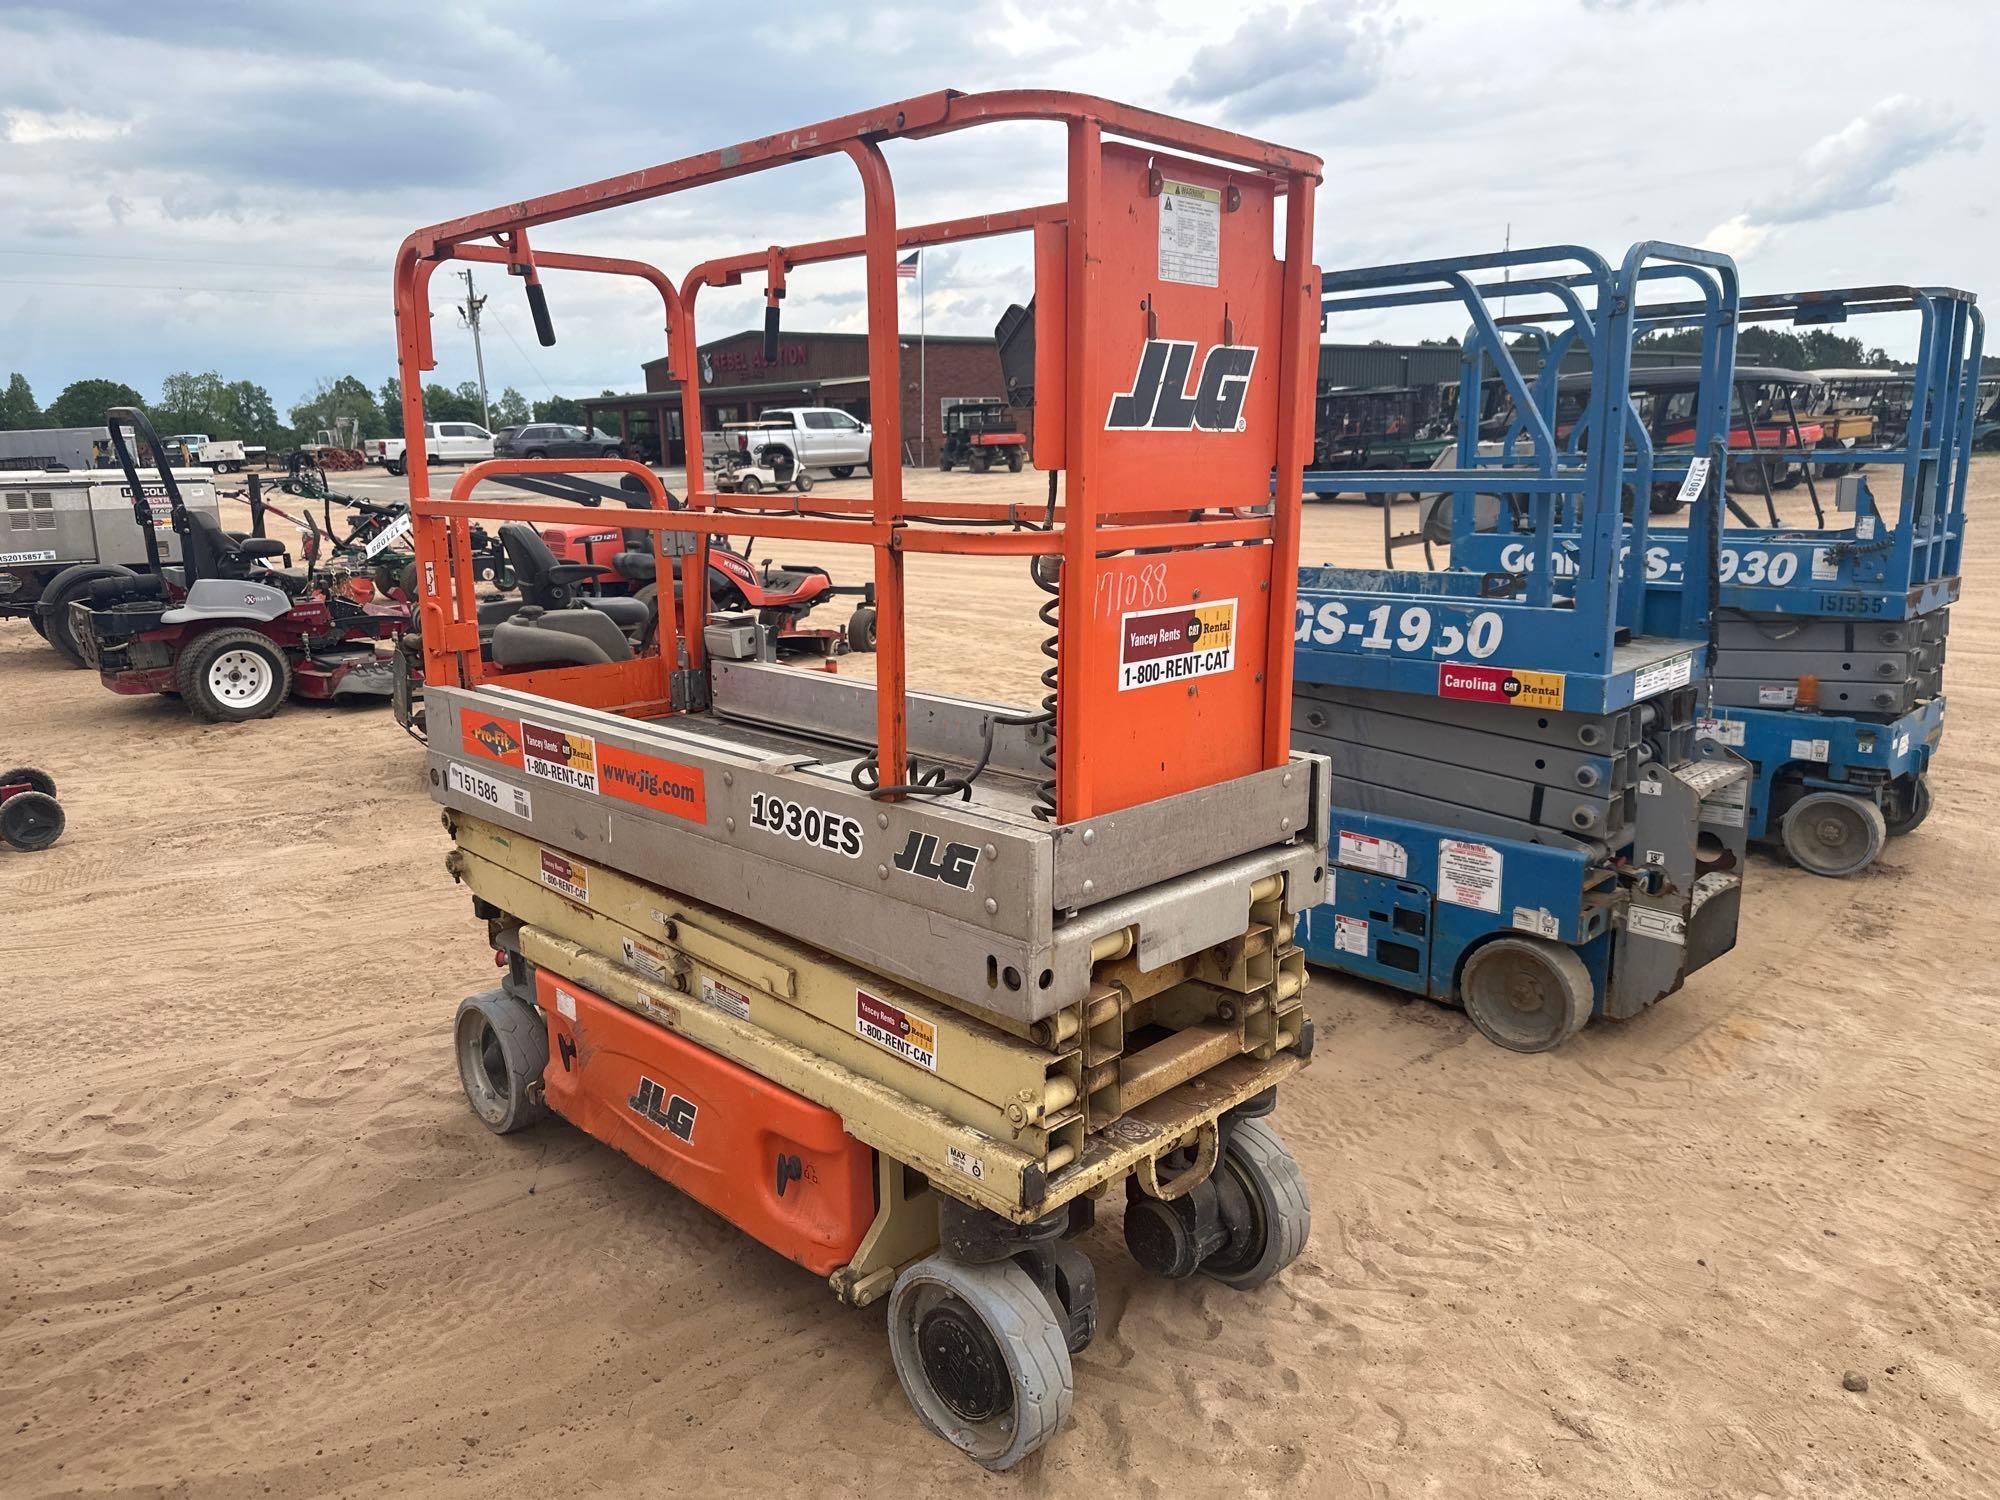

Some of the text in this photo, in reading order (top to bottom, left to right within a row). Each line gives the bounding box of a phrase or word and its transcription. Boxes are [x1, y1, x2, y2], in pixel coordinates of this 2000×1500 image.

[752, 344, 807, 368] ATION
[1105, 338, 1258, 431] JLG
[123, 488, 169, 497] LICOLN
[1686, 468, 1706, 497] 171089
[723, 560, 750, 578] KUBOTA
[1093, 563, 1167, 620] 171088
[1819, 595, 1883, 614] 151555
[1130, 622, 1230, 647] Yancey Rents CAT Rental
[1124, 650, 1230, 687] 1-800-RENT-CAT
[1444, 674, 1560, 696] Carolina CAT Rental
[573, 748, 592, 761] Rental
[458, 771, 498, 803] 151586
[527, 759, 594, 791] 1-800-RENT-CAT
[752, 793, 862, 857] 1930ES
[894, 830, 981, 890] JLG
[543, 872, 587, 900] 1-800-RENT-CAT
[861, 1001, 880, 1020] Yancey
[911, 1026, 933, 1043] Rental
[858, 1021, 933, 1066] 1-800-RENT-CAT
[628, 1075, 698, 1143] JLG
